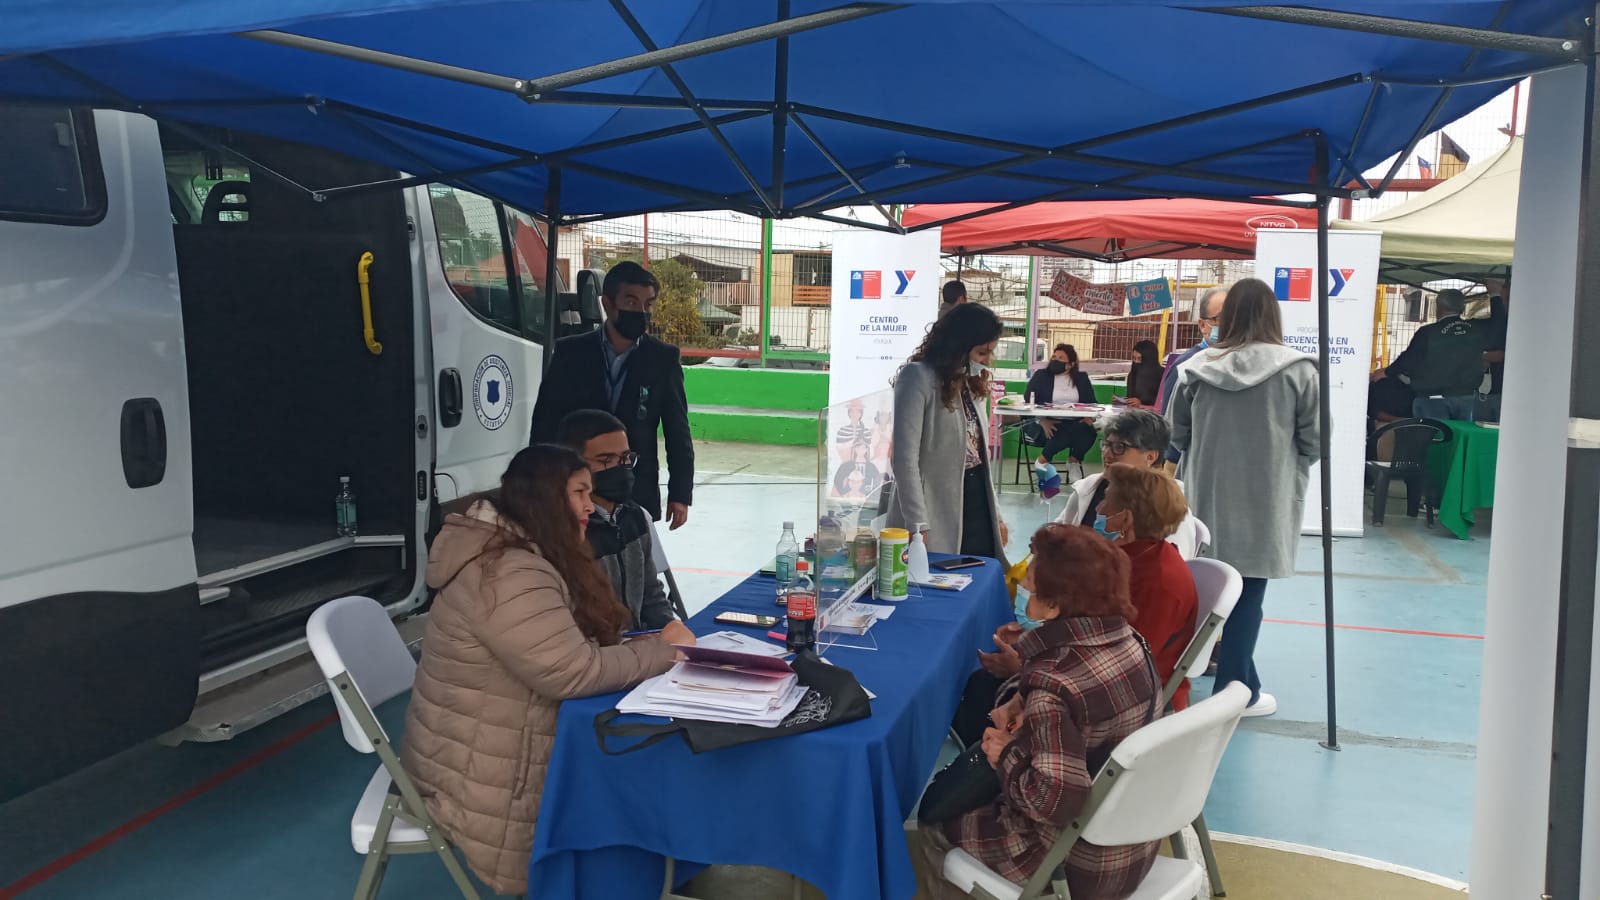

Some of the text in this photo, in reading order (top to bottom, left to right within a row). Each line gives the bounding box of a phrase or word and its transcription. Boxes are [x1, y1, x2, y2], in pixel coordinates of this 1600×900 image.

[869, 316, 899, 324] CENTRO
[860, 324, 908, 332] DE LA MUJER
[1283, 335, 1348, 345] REVENCN EN
